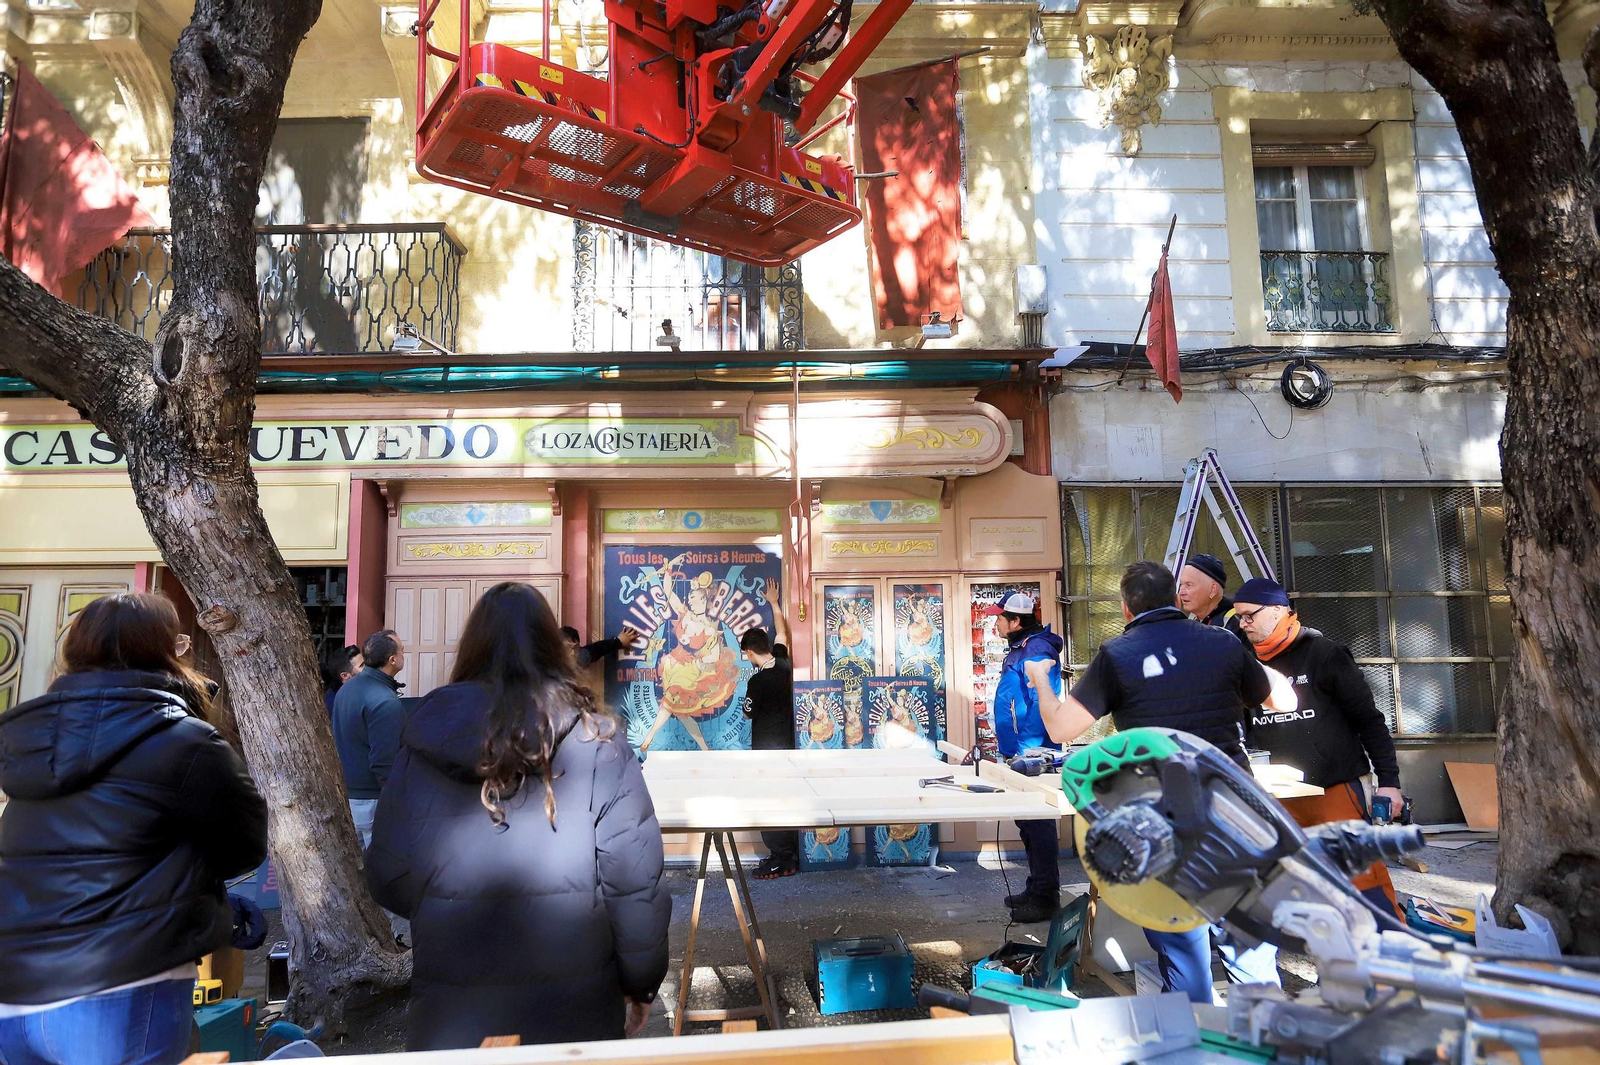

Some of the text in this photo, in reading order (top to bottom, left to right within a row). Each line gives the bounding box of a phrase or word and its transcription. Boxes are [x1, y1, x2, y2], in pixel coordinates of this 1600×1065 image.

[4, 424, 499, 466] CAS UEVEDO
[542, 432, 595, 449] LOZA
[618, 551, 646, 565] Tous
[648, 551, 664, 564] les
[686, 551, 713, 564] Soirs
[720, 551, 729, 564] 8
[731, 551, 766, 564] Heures
[633, 684, 652, 730] PANTOMIMES
[726, 696, 745, 726] BALLETS
[1252, 709, 1315, 726] NOVEDAD
